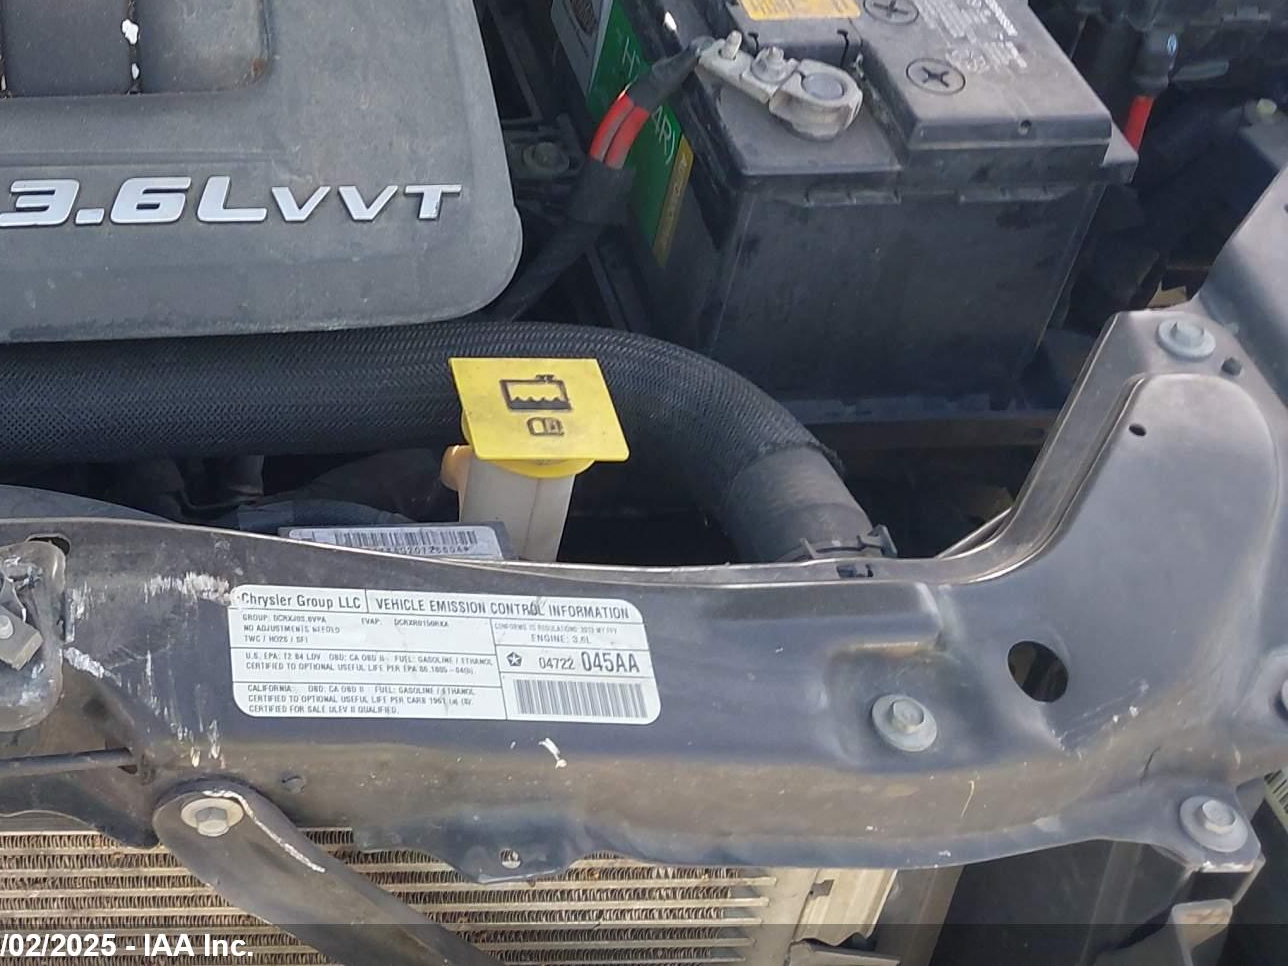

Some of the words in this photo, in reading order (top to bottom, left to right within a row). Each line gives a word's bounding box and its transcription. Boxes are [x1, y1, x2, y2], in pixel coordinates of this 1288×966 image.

[240, 591, 292, 608] Chrysler
[296, 594, 333, 609] Group
[338, 595, 361, 608] LLC
[375, 597, 425, 611] VEHICLE
[428, 599, 486, 613] EMISSION
[489, 601, 544, 616] CONTROL
[548, 603, 630, 619] INFORMATION
[243, 623, 254, 631] NO
[256, 624, 309, 633] ADJUSTMENTS
[529, 633, 569, 643] ENGINE:
[417, 655, 453, 664] GASOLINE
[538, 656, 575, 670] 04722
[579, 651, 640, 672] 045AA
[245, 661, 283, 669] CERTIFIED
[286, 662, 296, 670] TO
[298, 662, 334, 671] OPTIONAL
[337, 663, 365, 672] USEFUL
[398, 686, 433, 694] GASOLINE
[248, 693, 286, 702] CERTIFIED
[288, 694, 299, 702] TO
[300, 695, 337, 703] OPTIONAL
[340, 695, 368, 704] USEFUL
[248, 704, 287, 712] CERTIFIED
[289, 704, 304, 713] FOR
[307, 705, 325, 713] SALE
